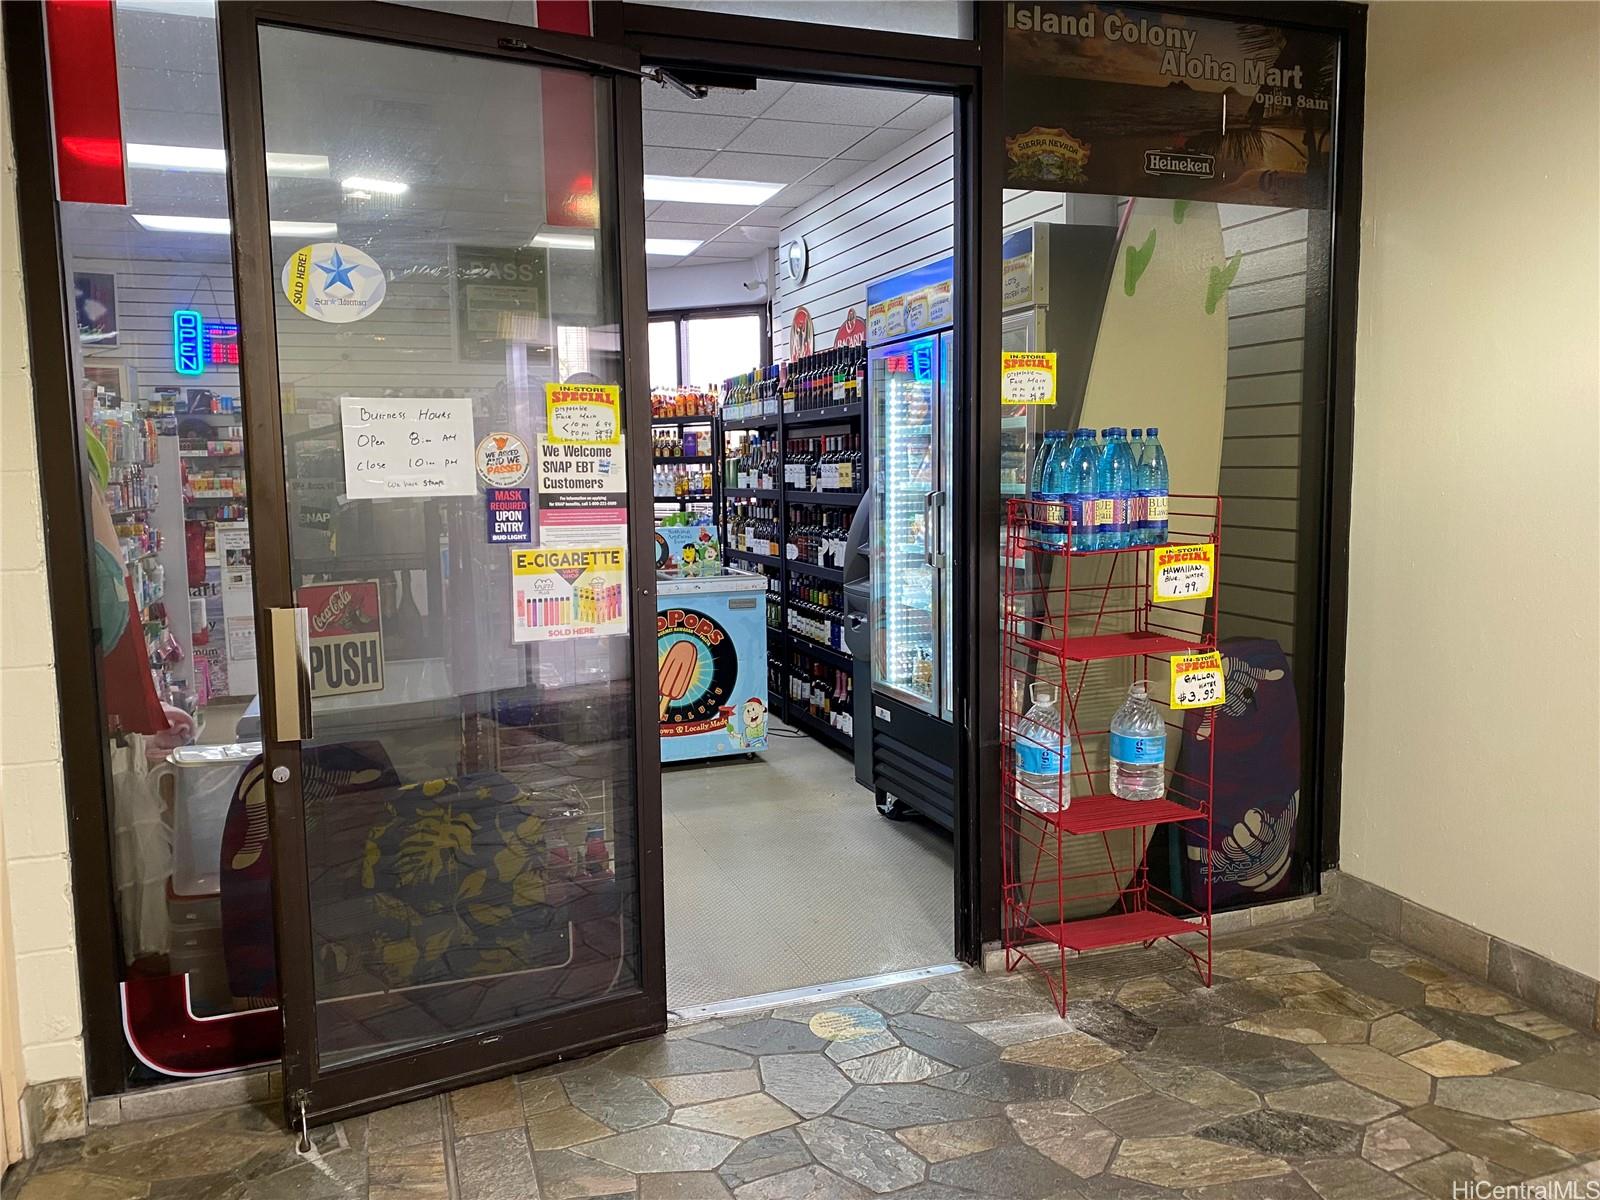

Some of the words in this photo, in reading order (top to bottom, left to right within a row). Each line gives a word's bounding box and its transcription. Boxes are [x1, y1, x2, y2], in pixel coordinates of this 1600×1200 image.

[1007, 2, 1096, 38] Island
[1103, 15, 1198, 52] Colony
[1160, 50, 1238, 83] Aloha
[1243, 58, 1304, 89] Mart
[1255, 92, 1293, 108] open
[1296, 95, 1329, 110] 8am
[1017, 139, 1047, 152] SIERRA
[1048, 139, 1079, 155] NEVADA
[1149, 155, 1211, 174] Heineken
[296, 253, 308, 280] HERE!
[293, 281, 305, 305] SOLD
[179, 314, 198, 371] OPEN
[1004, 359, 1053, 369] SPECIAL
[552, 391, 615, 405] SPECIAL
[418, 408, 452, 422] Hours
[485, 451, 497, 459] WE
[542, 445, 560, 457] We
[563, 445, 612, 457] Welcome
[506, 455, 521, 464] WE
[542, 460, 572, 473] SNAP
[575, 461, 595, 473] EBT
[486, 463, 522, 475] PASSED
[543, 476, 604, 489] Customers
[495, 490, 522, 501] MASK
[490, 501, 527, 511] REQUIRED
[495, 510, 523, 522] UPON
[494, 522, 524, 533] ENTRY
[517, 550, 621, 568] E-CIGARETTE
[1158, 551, 1210, 566] SPECIAL
[572, 627, 595, 635] HERE
[309, 640, 380, 691] PUSH
[1175, 659, 1220, 673] SPECIAL
